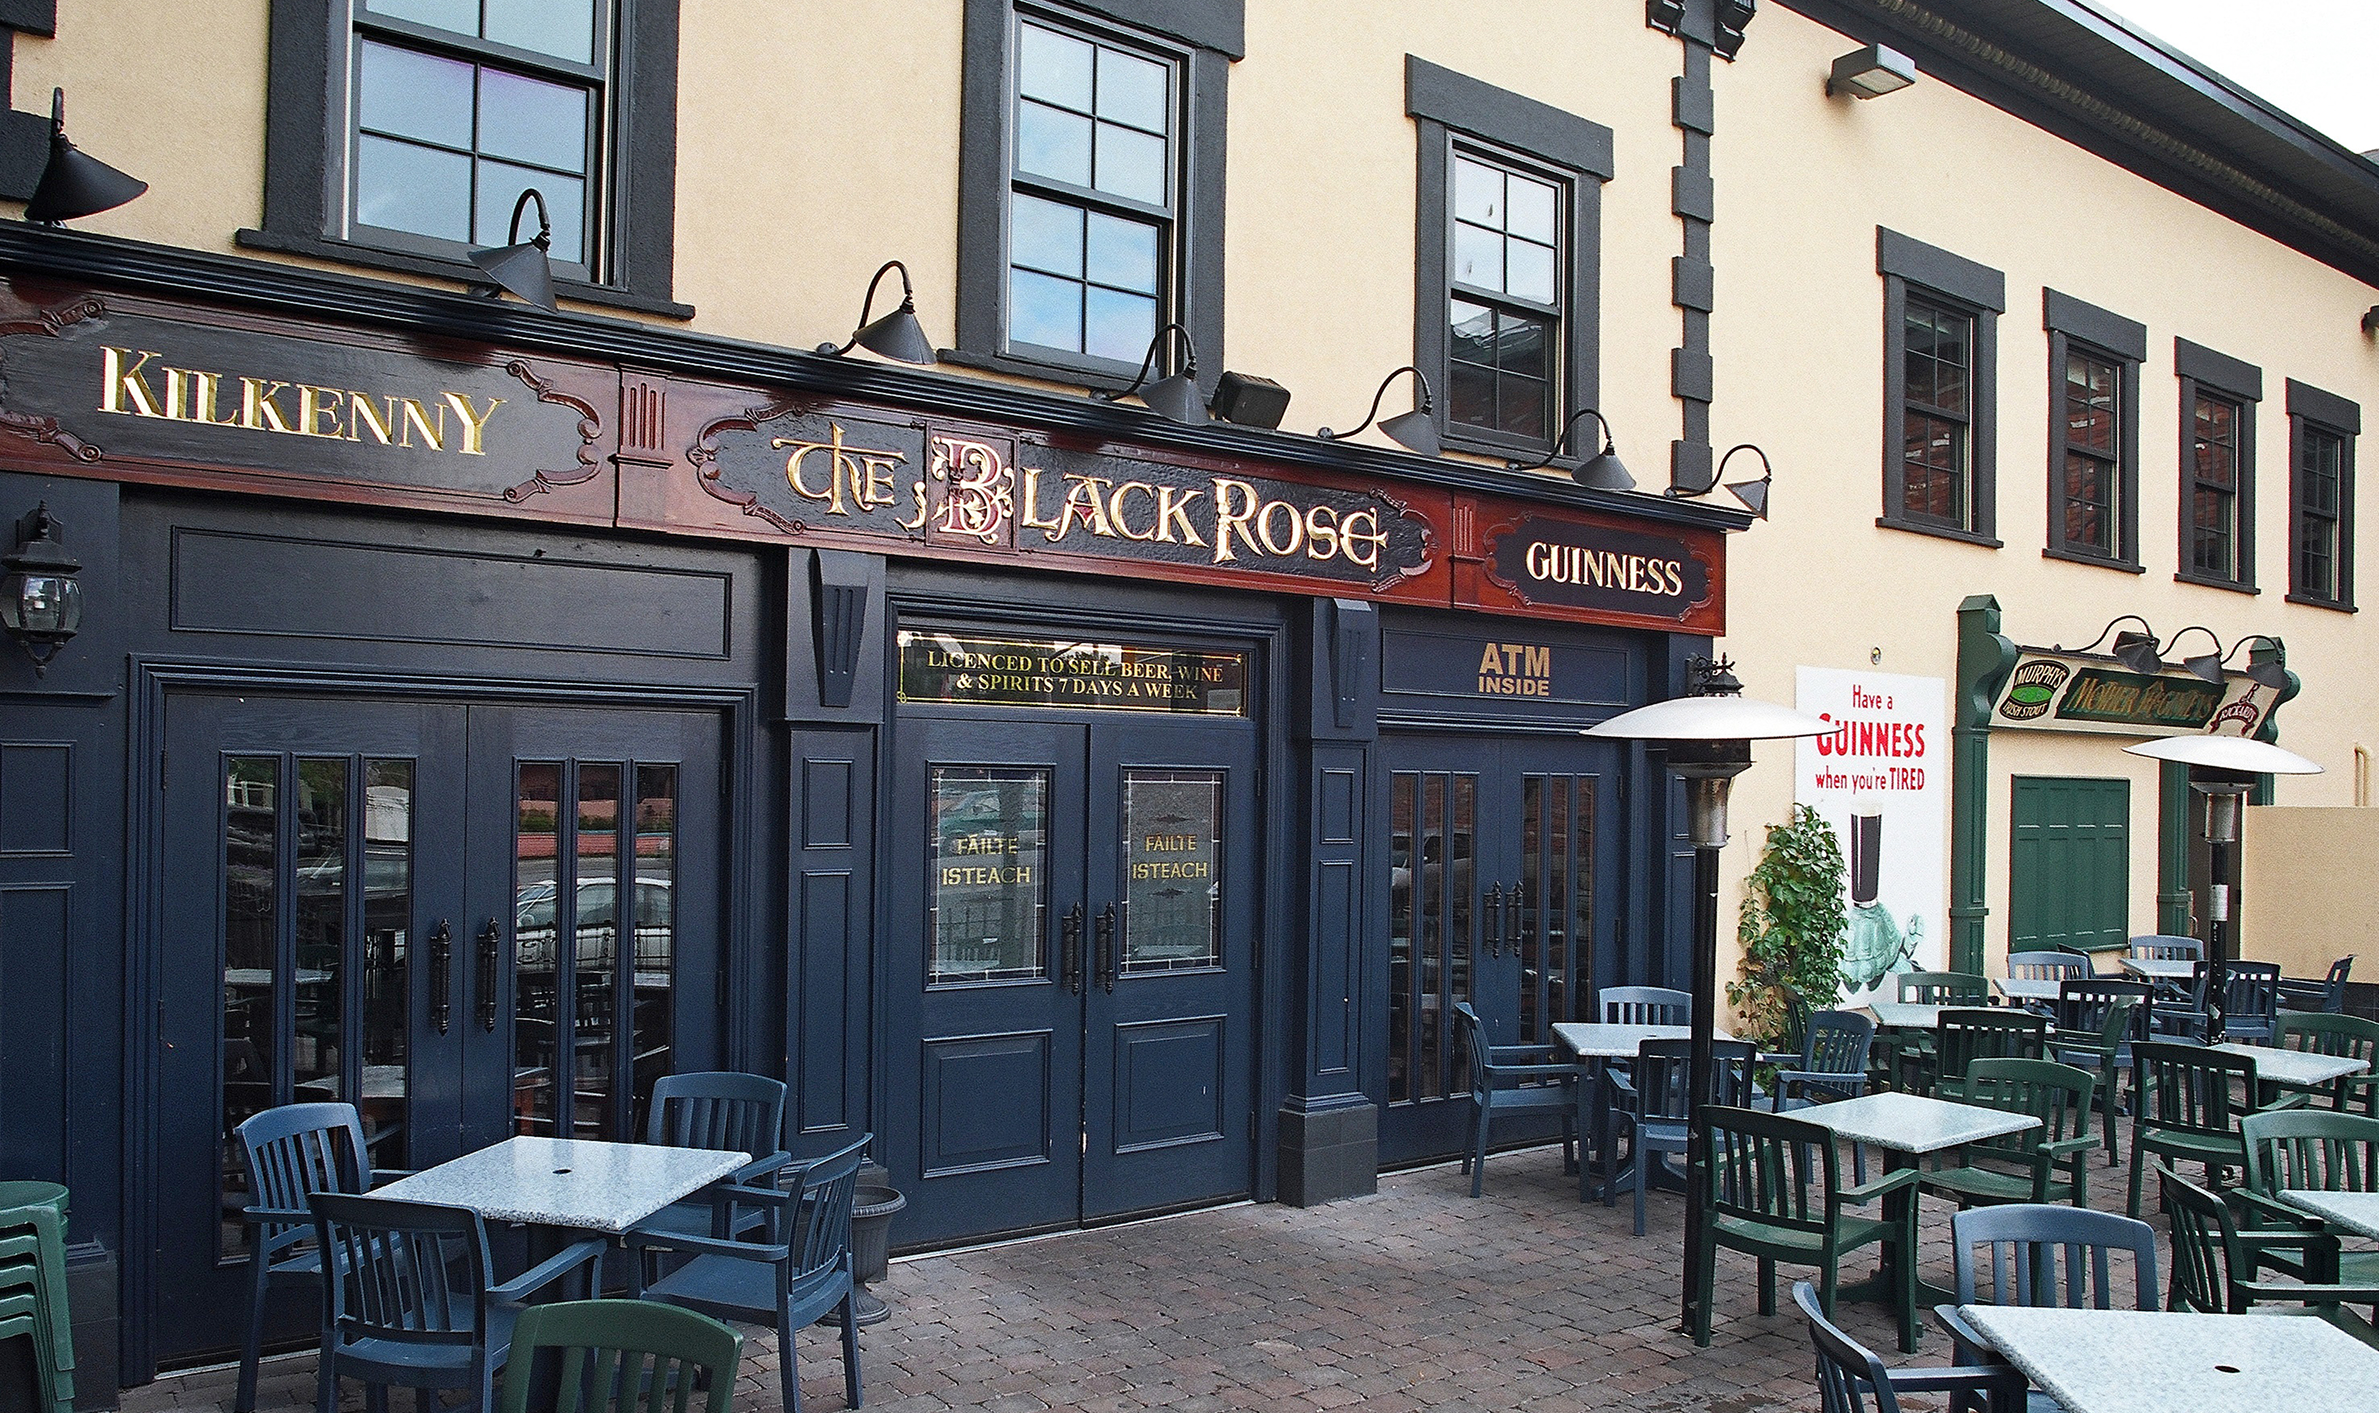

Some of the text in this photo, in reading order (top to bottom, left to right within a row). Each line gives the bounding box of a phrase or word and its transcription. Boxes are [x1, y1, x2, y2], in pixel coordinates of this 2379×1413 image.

[98, 345, 508, 457] KILKENNY
[894, 434, 1210, 547] BLACK
[1211, 477, 1389, 573] ROSE
[1525, 540, 1684, 597] GUINNESS
[927, 650, 1224, 683] LICENCED TO SELL BEER, WINE
[1479, 642, 1551, 678] ATM
[956, 672, 1198, 700] & SPIRITS 7 DAYS A WEEK
[1478, 676, 1550, 697] INSIDE
[1852, 684, 1893, 710] Have a
[2002, 700, 2049, 718] IRISH STOUT
[1816, 712, 1926, 758] GUINNESS
[1815, 765, 1925, 795] when you're TIRED
[957, 834, 1018, 855] FÁILTE
[1145, 832, 1197, 852] FÁILTE
[942, 866, 1031, 886] ISTEACH
[1132, 861, 1207, 880] ISTEACH
